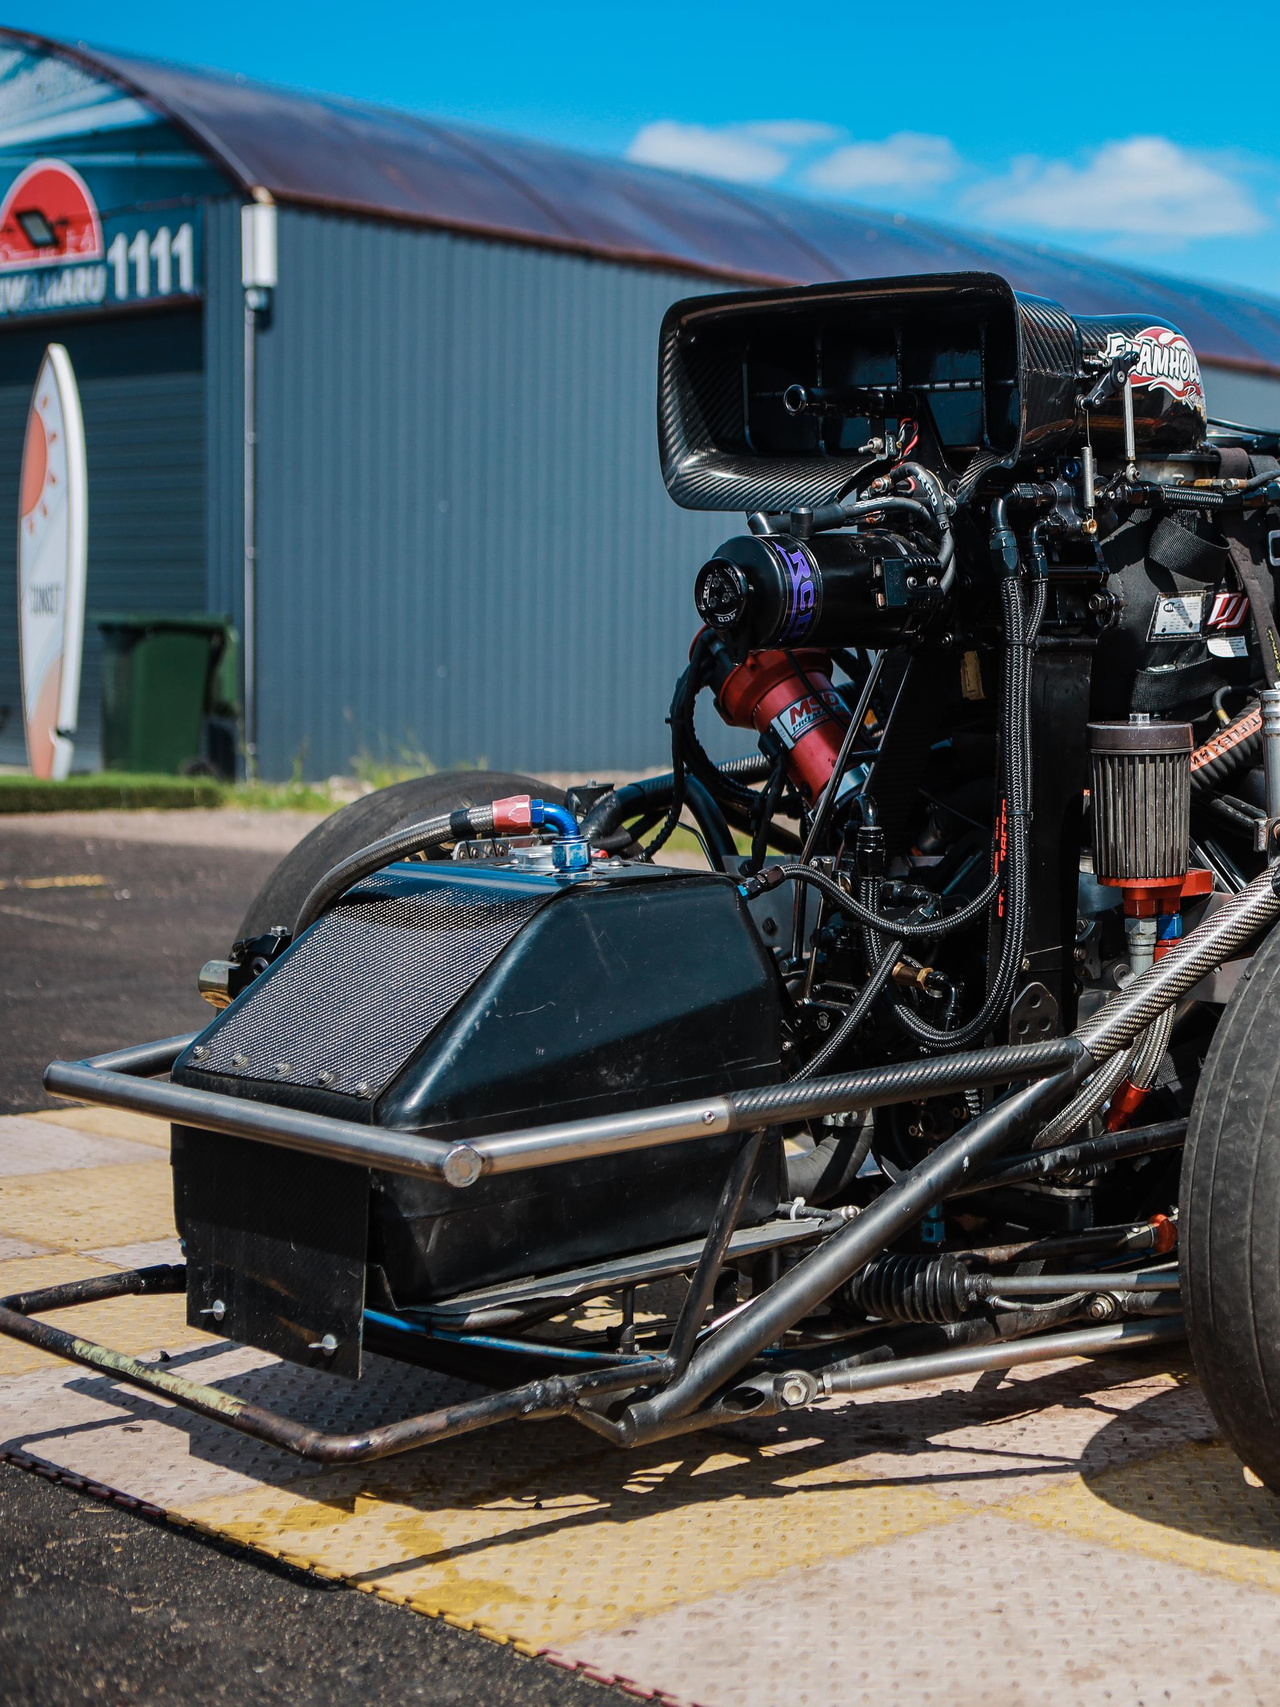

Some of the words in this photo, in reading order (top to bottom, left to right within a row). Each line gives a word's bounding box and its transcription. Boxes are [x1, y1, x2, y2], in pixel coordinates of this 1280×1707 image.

[106, 222, 194, 300] 1111
[918, 473, 939, 506] RCD
[1211, 714, 1261, 752] TIFLEX
